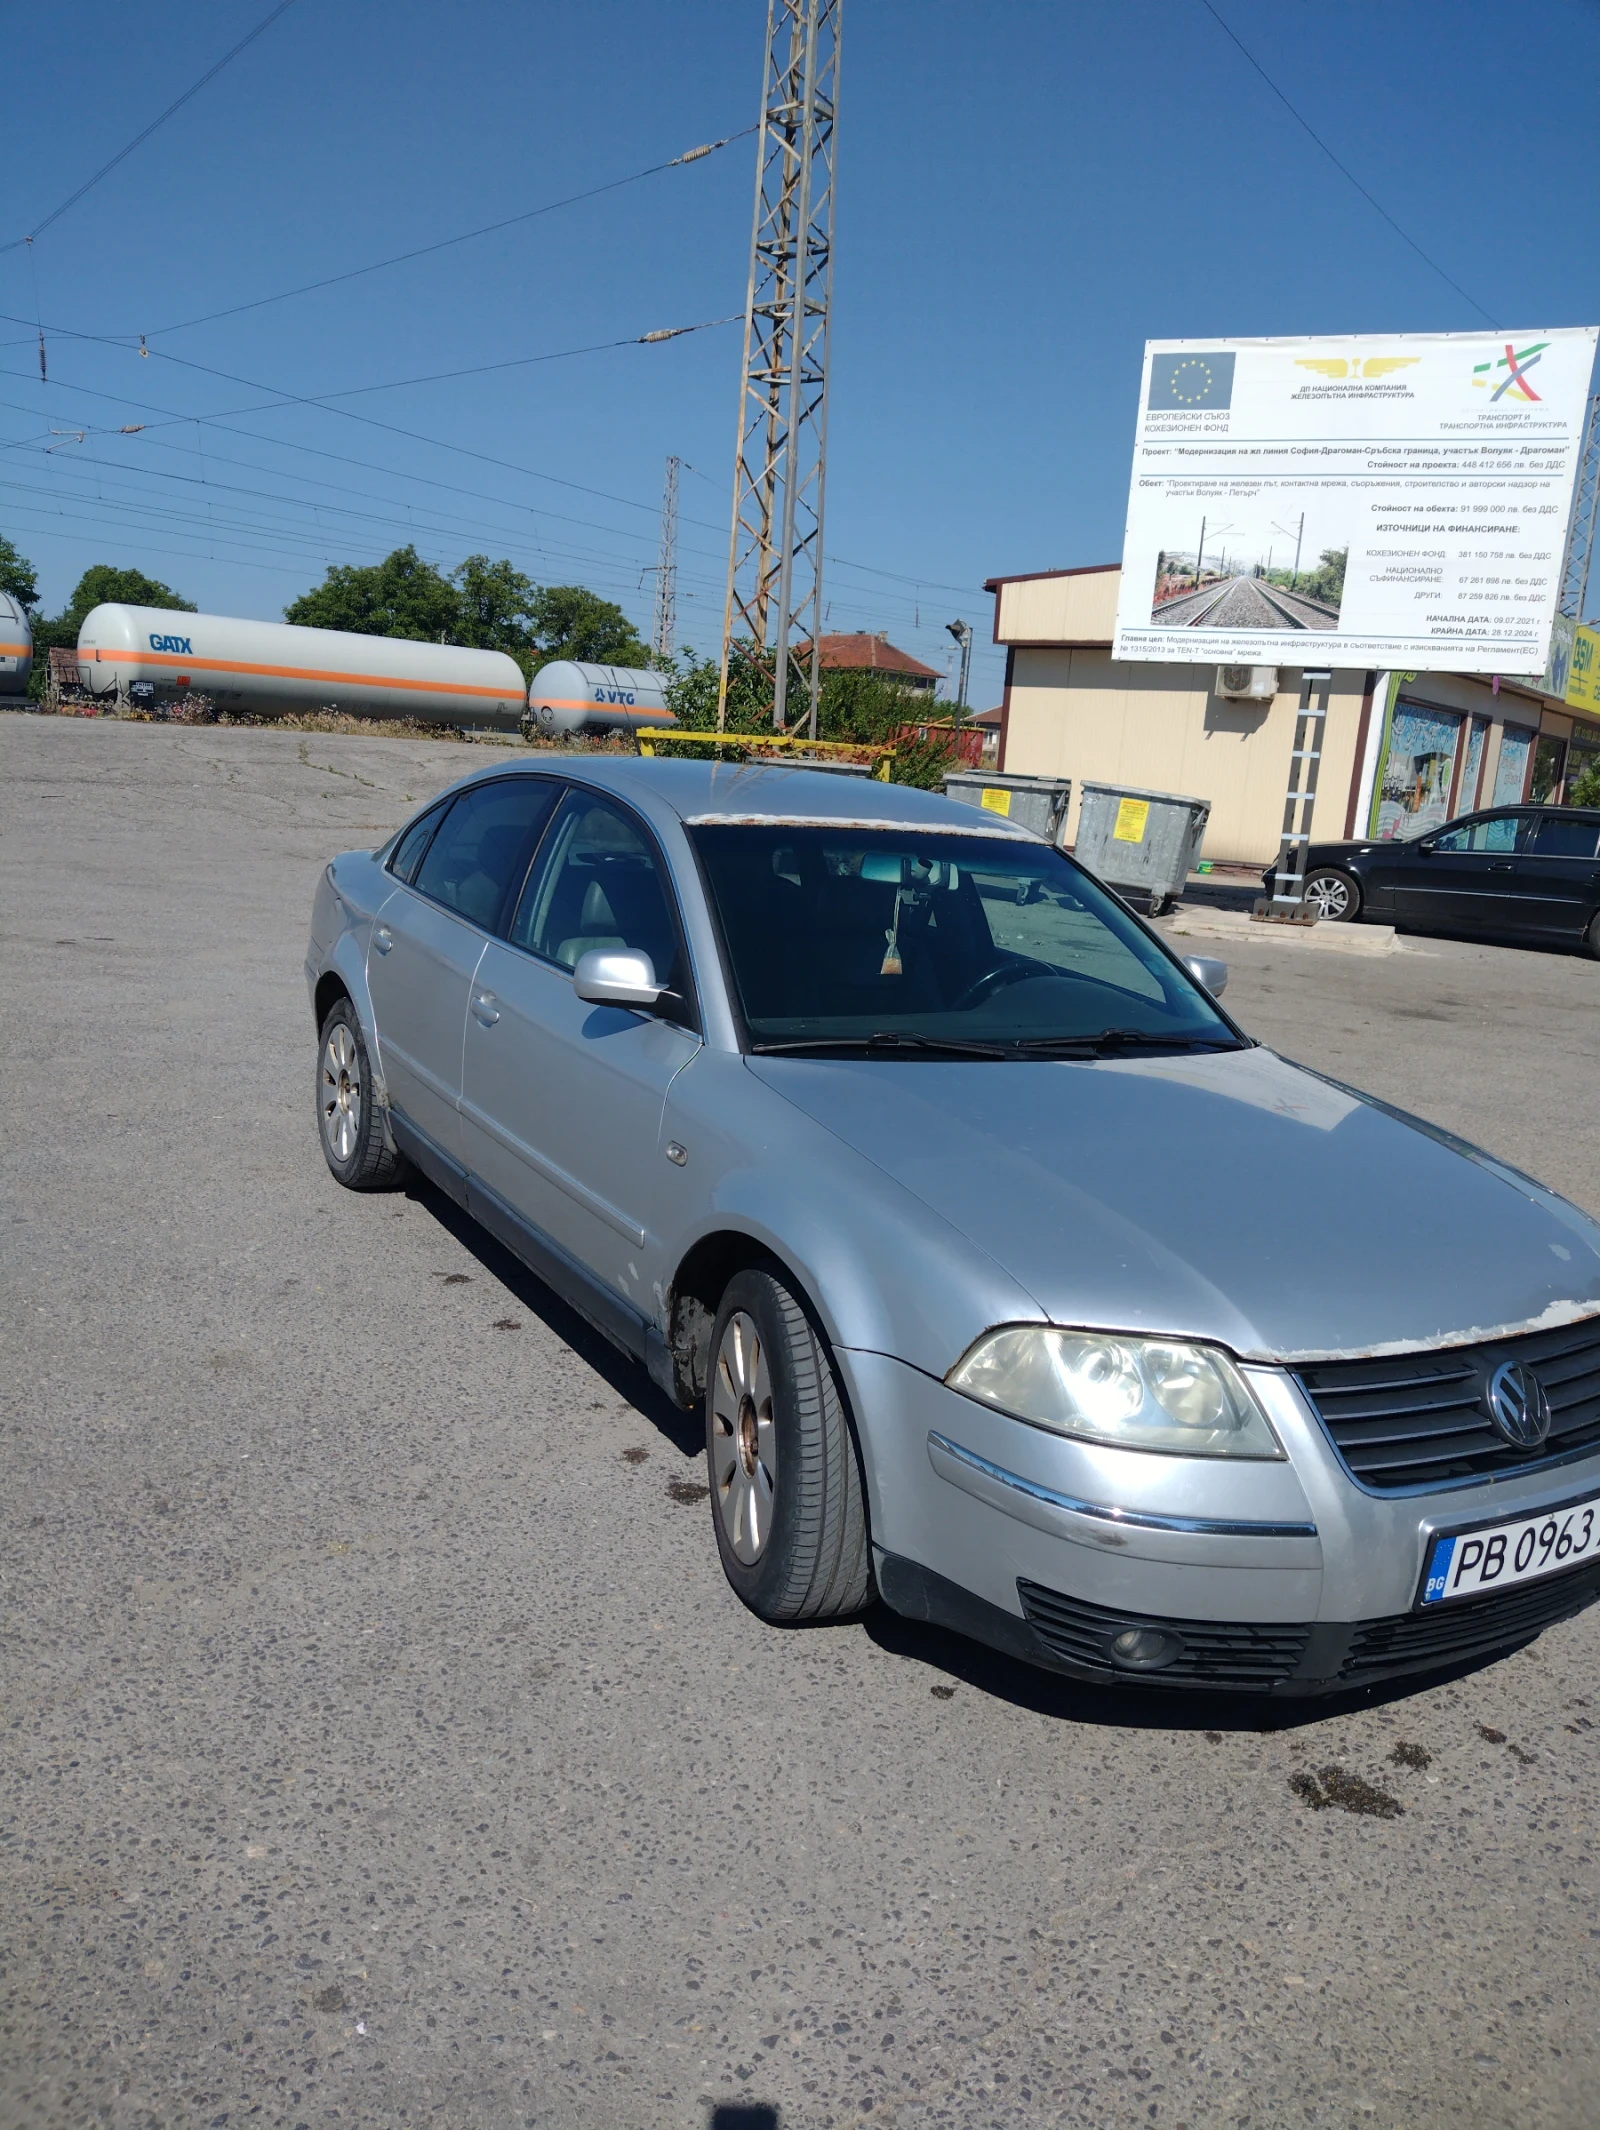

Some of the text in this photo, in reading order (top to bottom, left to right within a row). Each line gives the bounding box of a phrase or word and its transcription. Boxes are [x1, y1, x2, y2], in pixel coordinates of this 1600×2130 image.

[1146, 412, 1231, 421] ЕВРОПЕЙСКИ СЪЮЗ
[1144, 424, 1229, 432] КОХЕЗИОНЕН ФОНД
[1142, 448, 1172, 456] Проект:
[1290, 446, 1402, 456] София-Драгоман-Сръбска
[1403, 448, 1441, 456] граница,
[1443, 447, 1479, 456] участък
[1480, 446, 1513, 455] Волуяк
[1367, 460, 1408, 468] Стойност
[1461, 460, 1478, 468] 448
[1479, 460, 1495, 468] 412
[1496, 460, 1512, 468] 656
[1529, 460, 1544, 468] без
[1545, 460, 1566, 470] ДДС
[1264, 480, 1279, 488] път,
[1320, 480, 1349, 488] мрежа,
[1350, 480, 1402, 488] съоръжения,
[1468, 480, 1504, 489] авторски
[1507, 480, 1538, 489] надзор
[1165, 489, 1196, 498] участък
[1196, 489, 1223, 498] Волуяк
[1371, 504, 1412, 512] Стойност
[1426, 504, 1458, 513] обекта:
[1460, 505, 1470, 513] 91
[1472, 505, 1488, 513] 999
[1490, 505, 1506, 513] 000
[1522, 506, 1537, 514] без
[1538, 505, 1559, 515] ДДС
[1376, 524, 1521, 534] ИЗТОЧНИЦИ НА ФИНАНСИРАНЕ:
[1366, 550, 1420, 558] КОХЕЗИОНЕН
[1422, 550, 1448, 558] ФОНД:
[1533, 552, 1552, 560] ДДС
[1385, 566, 1444, 576] НАЦИОНАЛНО
[1369, 574, 1444, 583] СЪФИНАНСИРАНЕ:
[1514, 577, 1529, 586] без
[1529, 578, 1548, 586] ДДС
[1414, 592, 1443, 600] ДРУГИ:
[1528, 594, 1547, 602] ДДС
[1426, 615, 1466, 623] НАЧАЛНА
[1467, 616, 1492, 625] ДАТА:
[1493, 616, 1536, 625] 09.07.2021
[1430, 626, 1464, 636] КРАЙНА
[1464, 628, 1490, 637] ДАТА:
[149, 634, 193, 654] GATX
[1130, 645, 1165, 653] 1315/2013
[1148, 636, 1165, 644] цел:
[1166, 636, 1220, 646] Модернизация
[1231, 638, 1279, 646] железопътна
[1280, 640, 1342, 649] инфраструктура
[1350, 642, 1402, 650] съответствие
[1410, 644, 1464, 652] изискванията
[1477, 645, 1539, 656] Регламент(ЕС)
[607, 690, 634, 706] VTG
[1453, 1508, 1594, 1588] PB 0963
[1426, 1576, 1446, 1592] BG
